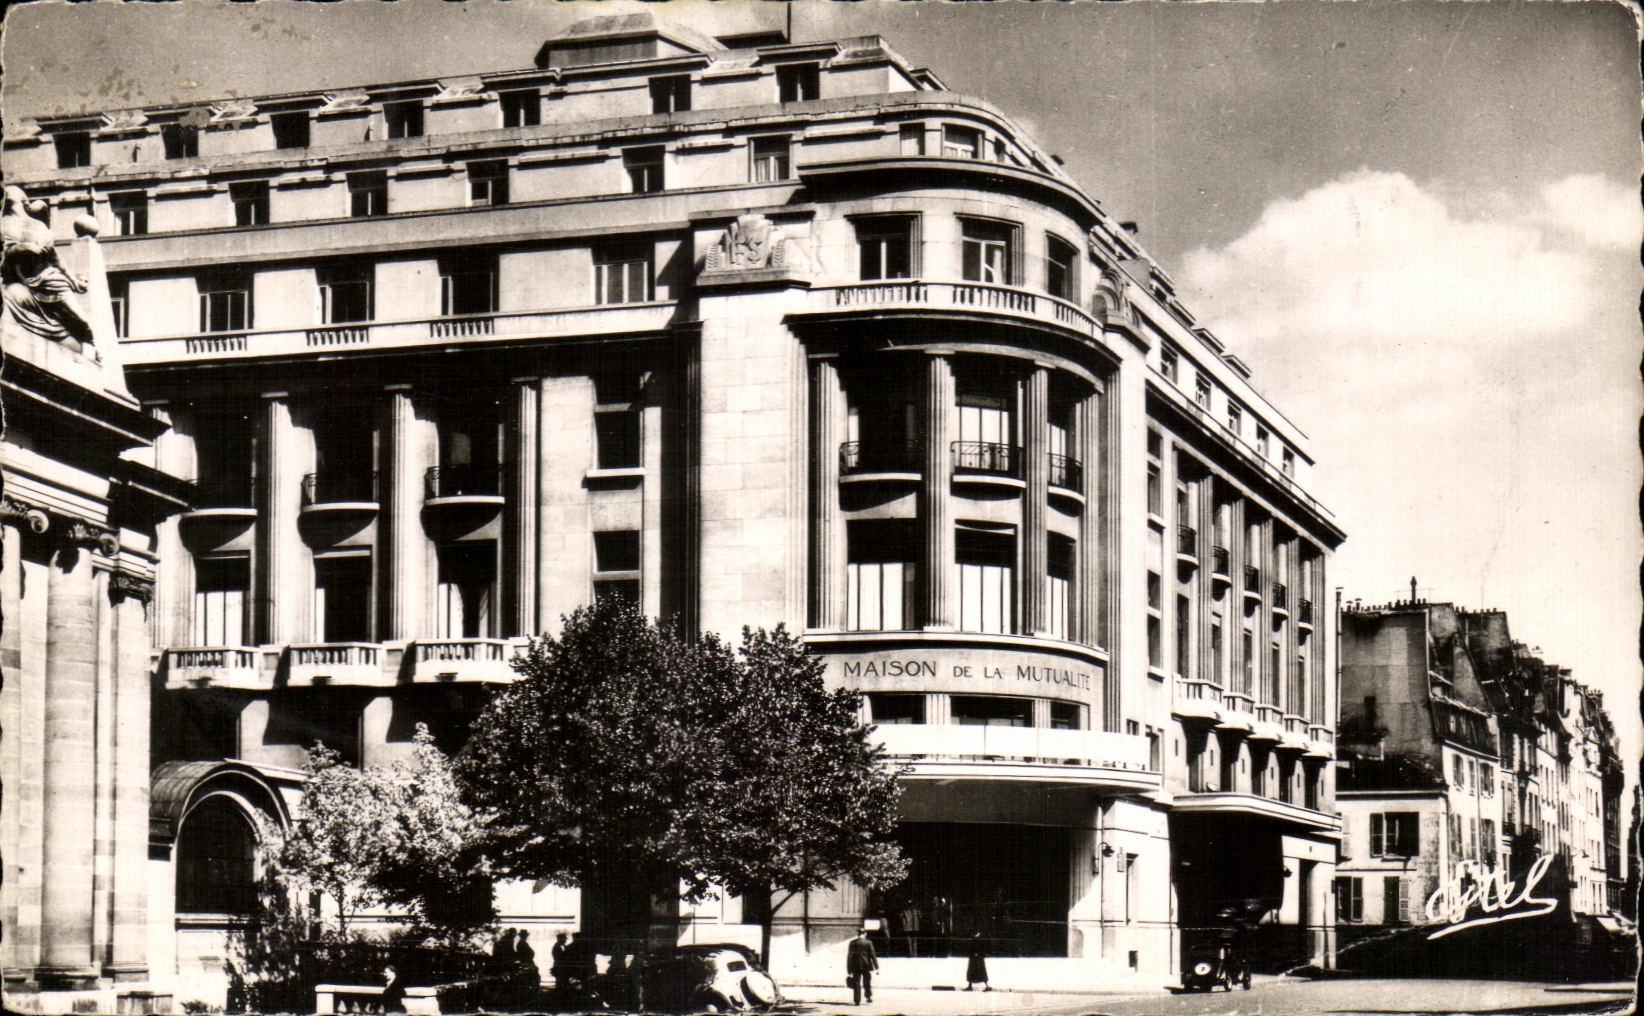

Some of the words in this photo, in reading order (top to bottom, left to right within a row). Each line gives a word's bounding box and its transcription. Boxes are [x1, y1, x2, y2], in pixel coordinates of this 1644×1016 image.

[843, 660, 936, 678] MAISON
[953, 665, 972, 678] DE
[984, 667, 1002, 679] LA
